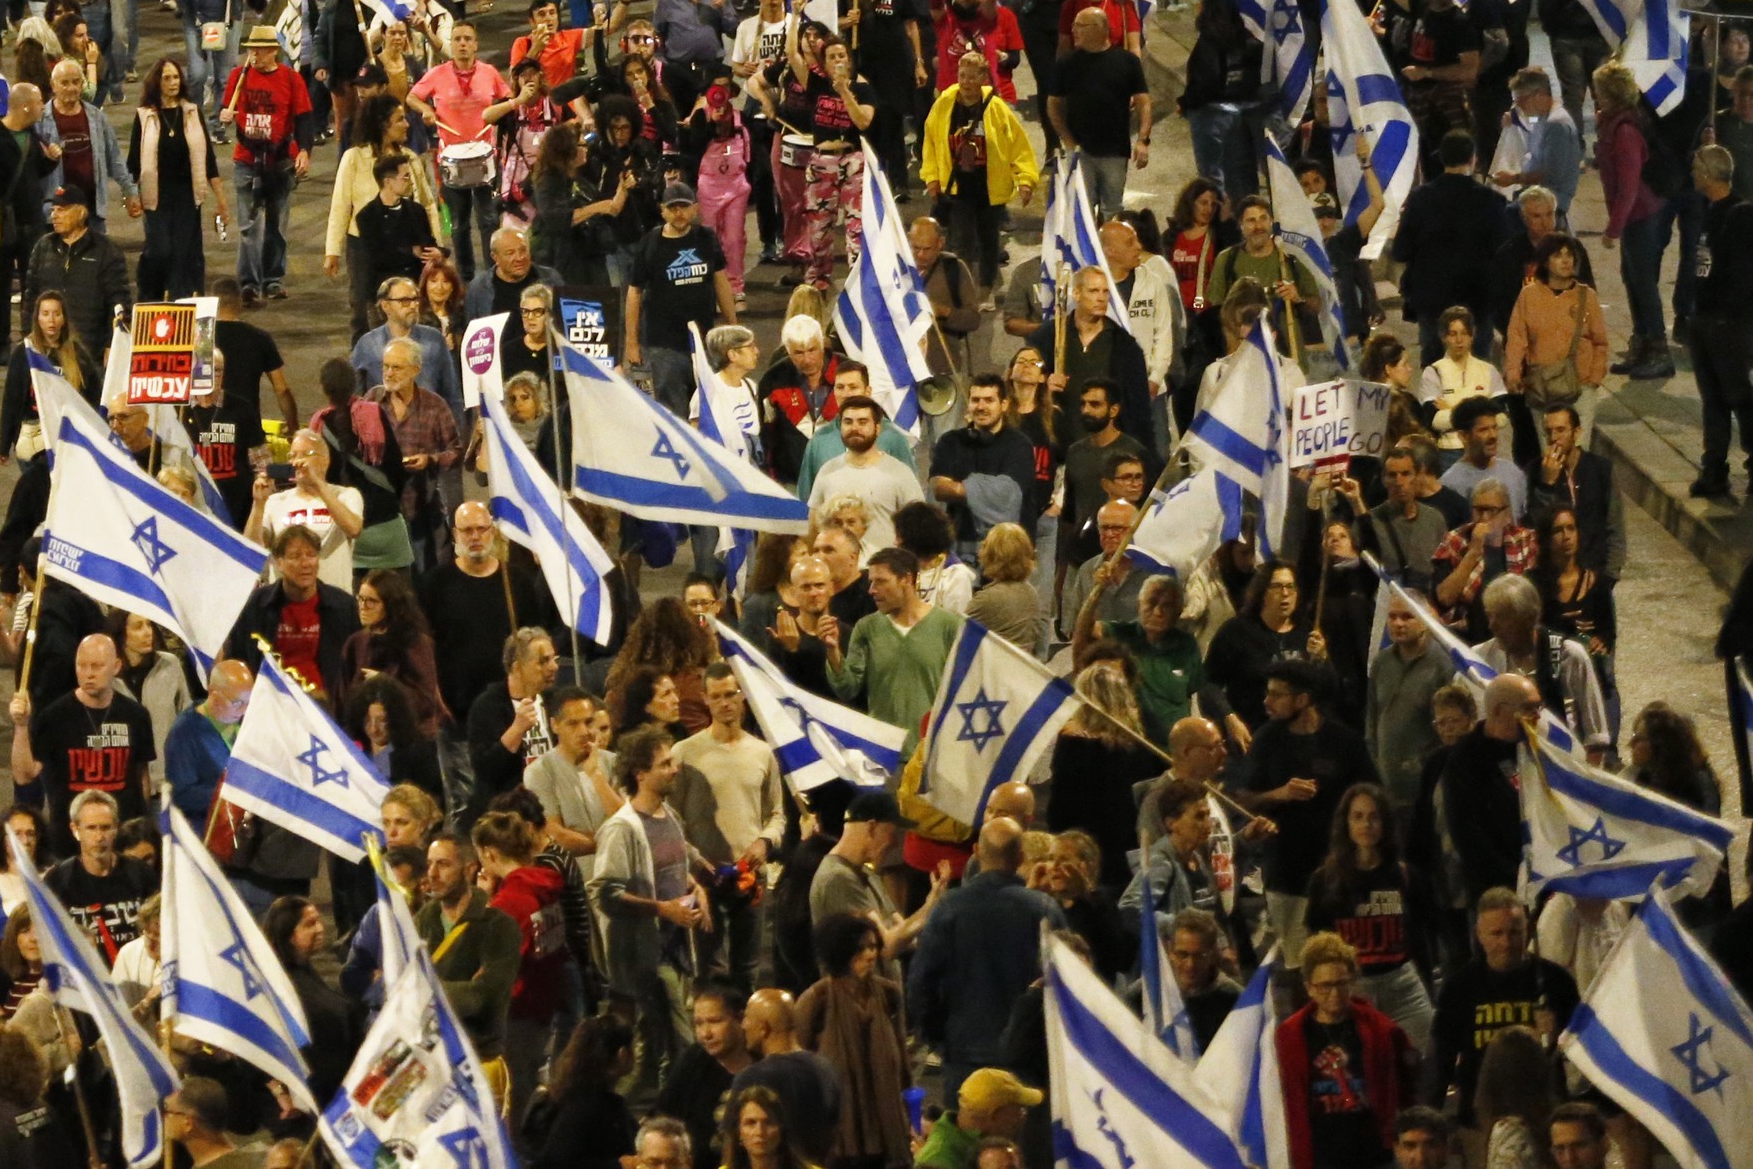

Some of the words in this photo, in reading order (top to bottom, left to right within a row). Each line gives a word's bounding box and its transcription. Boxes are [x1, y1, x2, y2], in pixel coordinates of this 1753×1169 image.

[577, 311, 599, 328] אין
[570, 327, 605, 342] לכם
[130, 376, 190, 400] עכשיו!
[1299, 383, 1345, 421] LET
[1356, 387, 1390, 412] MY
[1296, 417, 1350, 456] PEOPLE
[1348, 432, 1383, 454] GO
[68, 748, 130, 783] עכשיו
[1475, 1002, 1533, 1025] דחה
